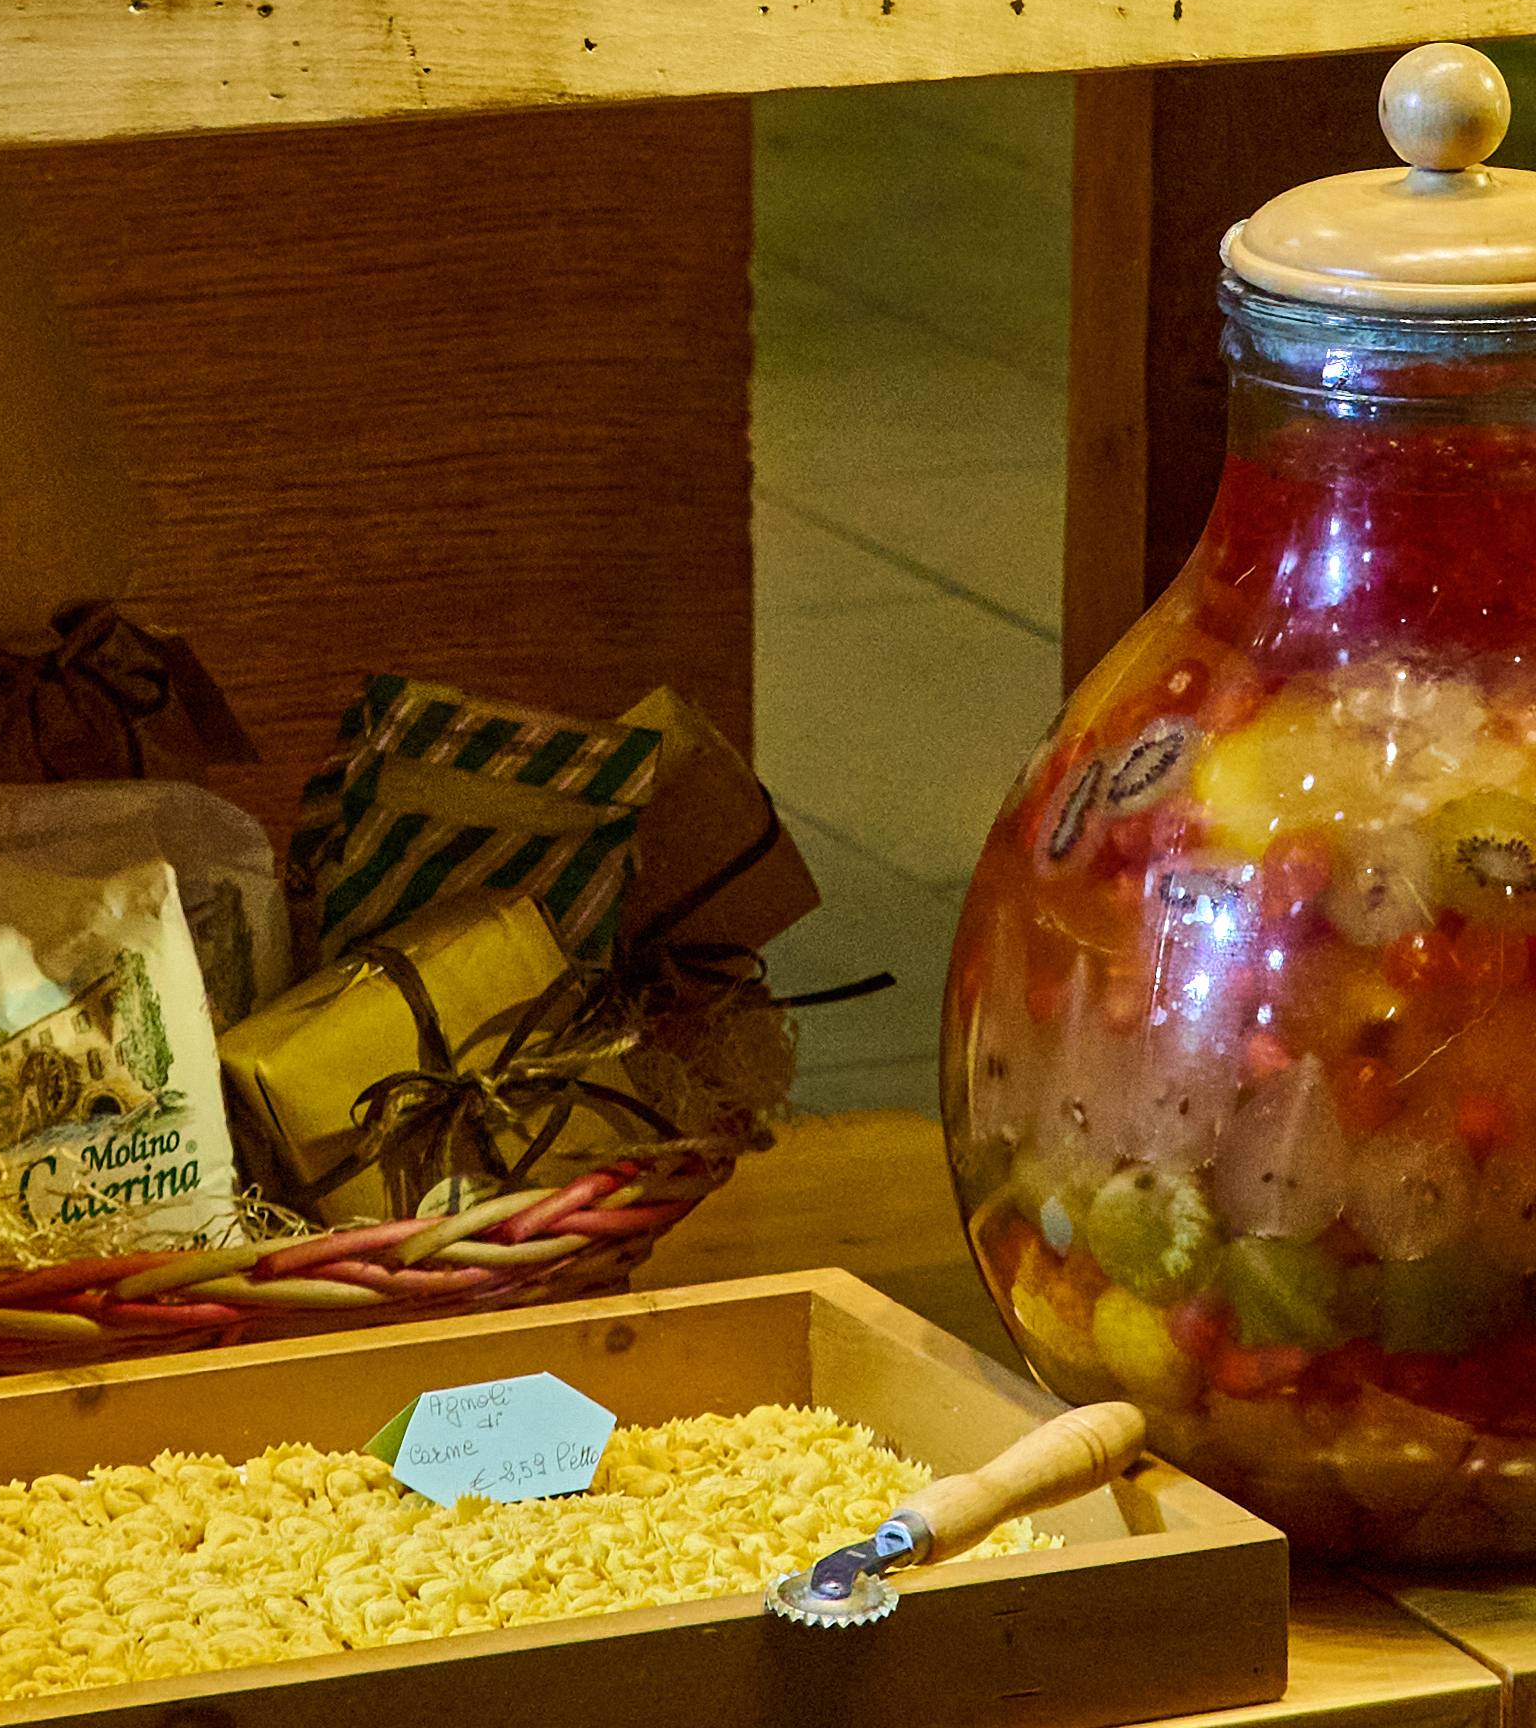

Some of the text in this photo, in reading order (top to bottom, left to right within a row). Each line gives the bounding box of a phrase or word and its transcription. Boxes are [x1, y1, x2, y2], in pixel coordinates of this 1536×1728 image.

[80, 1127, 181, 1173] Molino
[18, 1154, 202, 1228] Caterina
[429, 1382, 514, 1428] Agnoli
[477, 1411, 504, 1430] di
[469, 1468, 496, 1491] €
